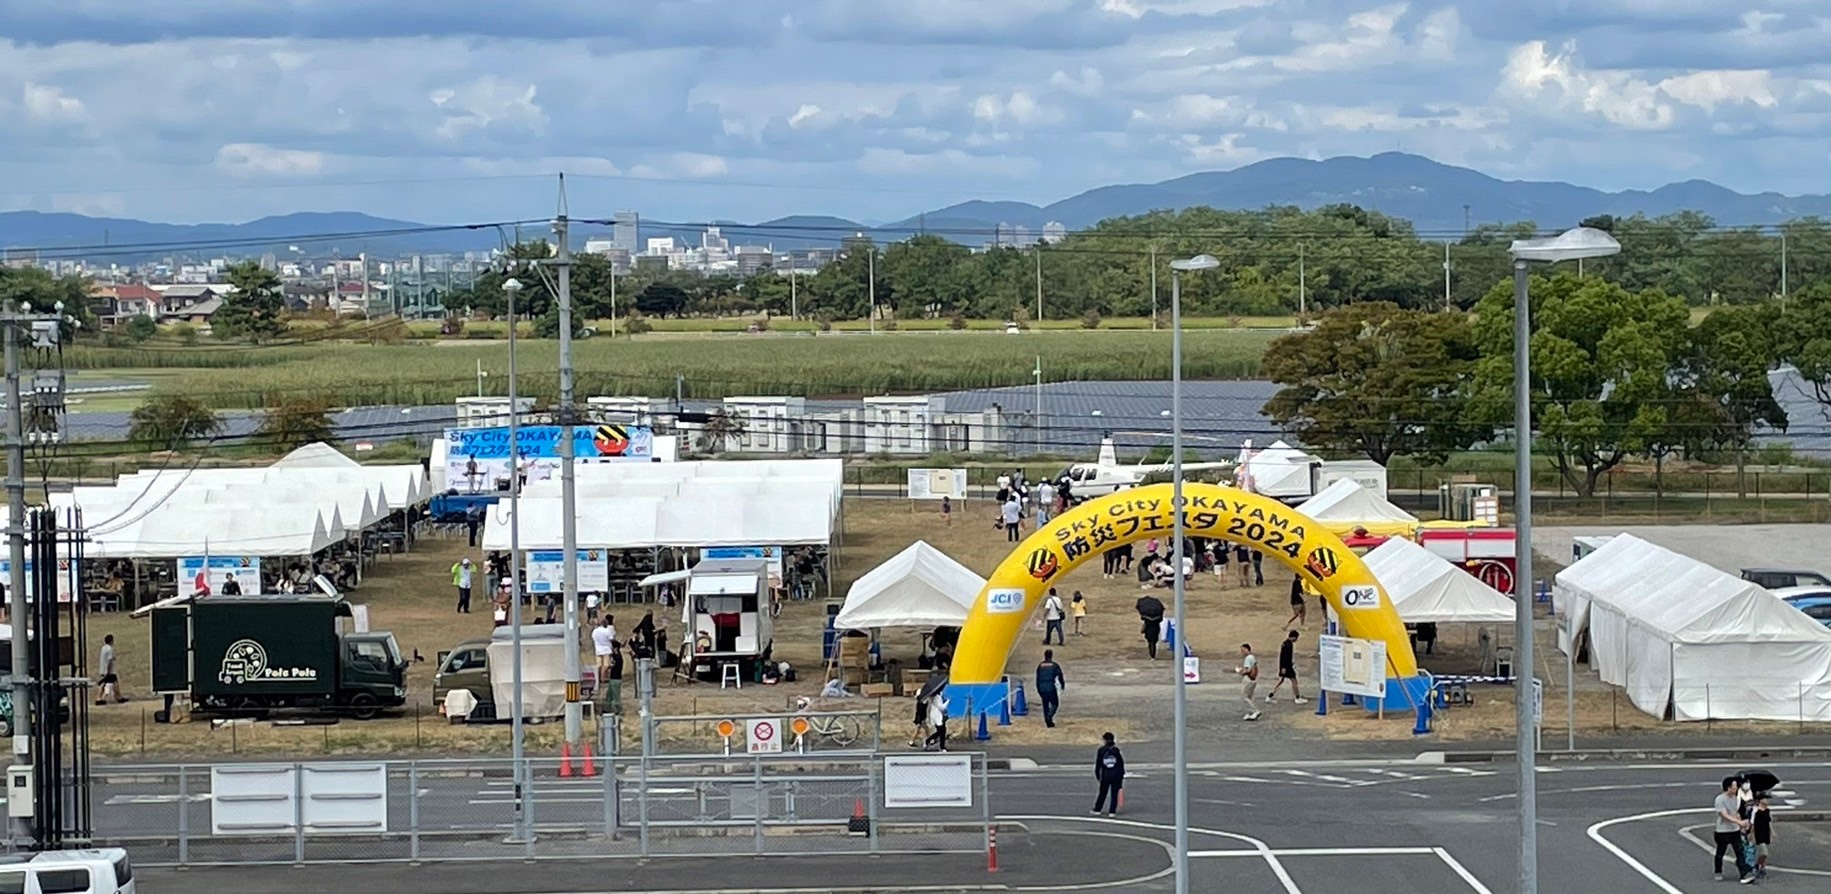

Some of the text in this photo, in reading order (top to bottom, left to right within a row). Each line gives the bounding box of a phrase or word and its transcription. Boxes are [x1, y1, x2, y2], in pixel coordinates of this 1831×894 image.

[449, 431, 477, 443] Sky
[481, 431, 511, 443] City
[1055, 496, 1305, 541] Sky City OKAYAMA
[1062, 511, 1302, 562] 防災フェスタ 2024
[991, 593, 1011, 603] JCI
